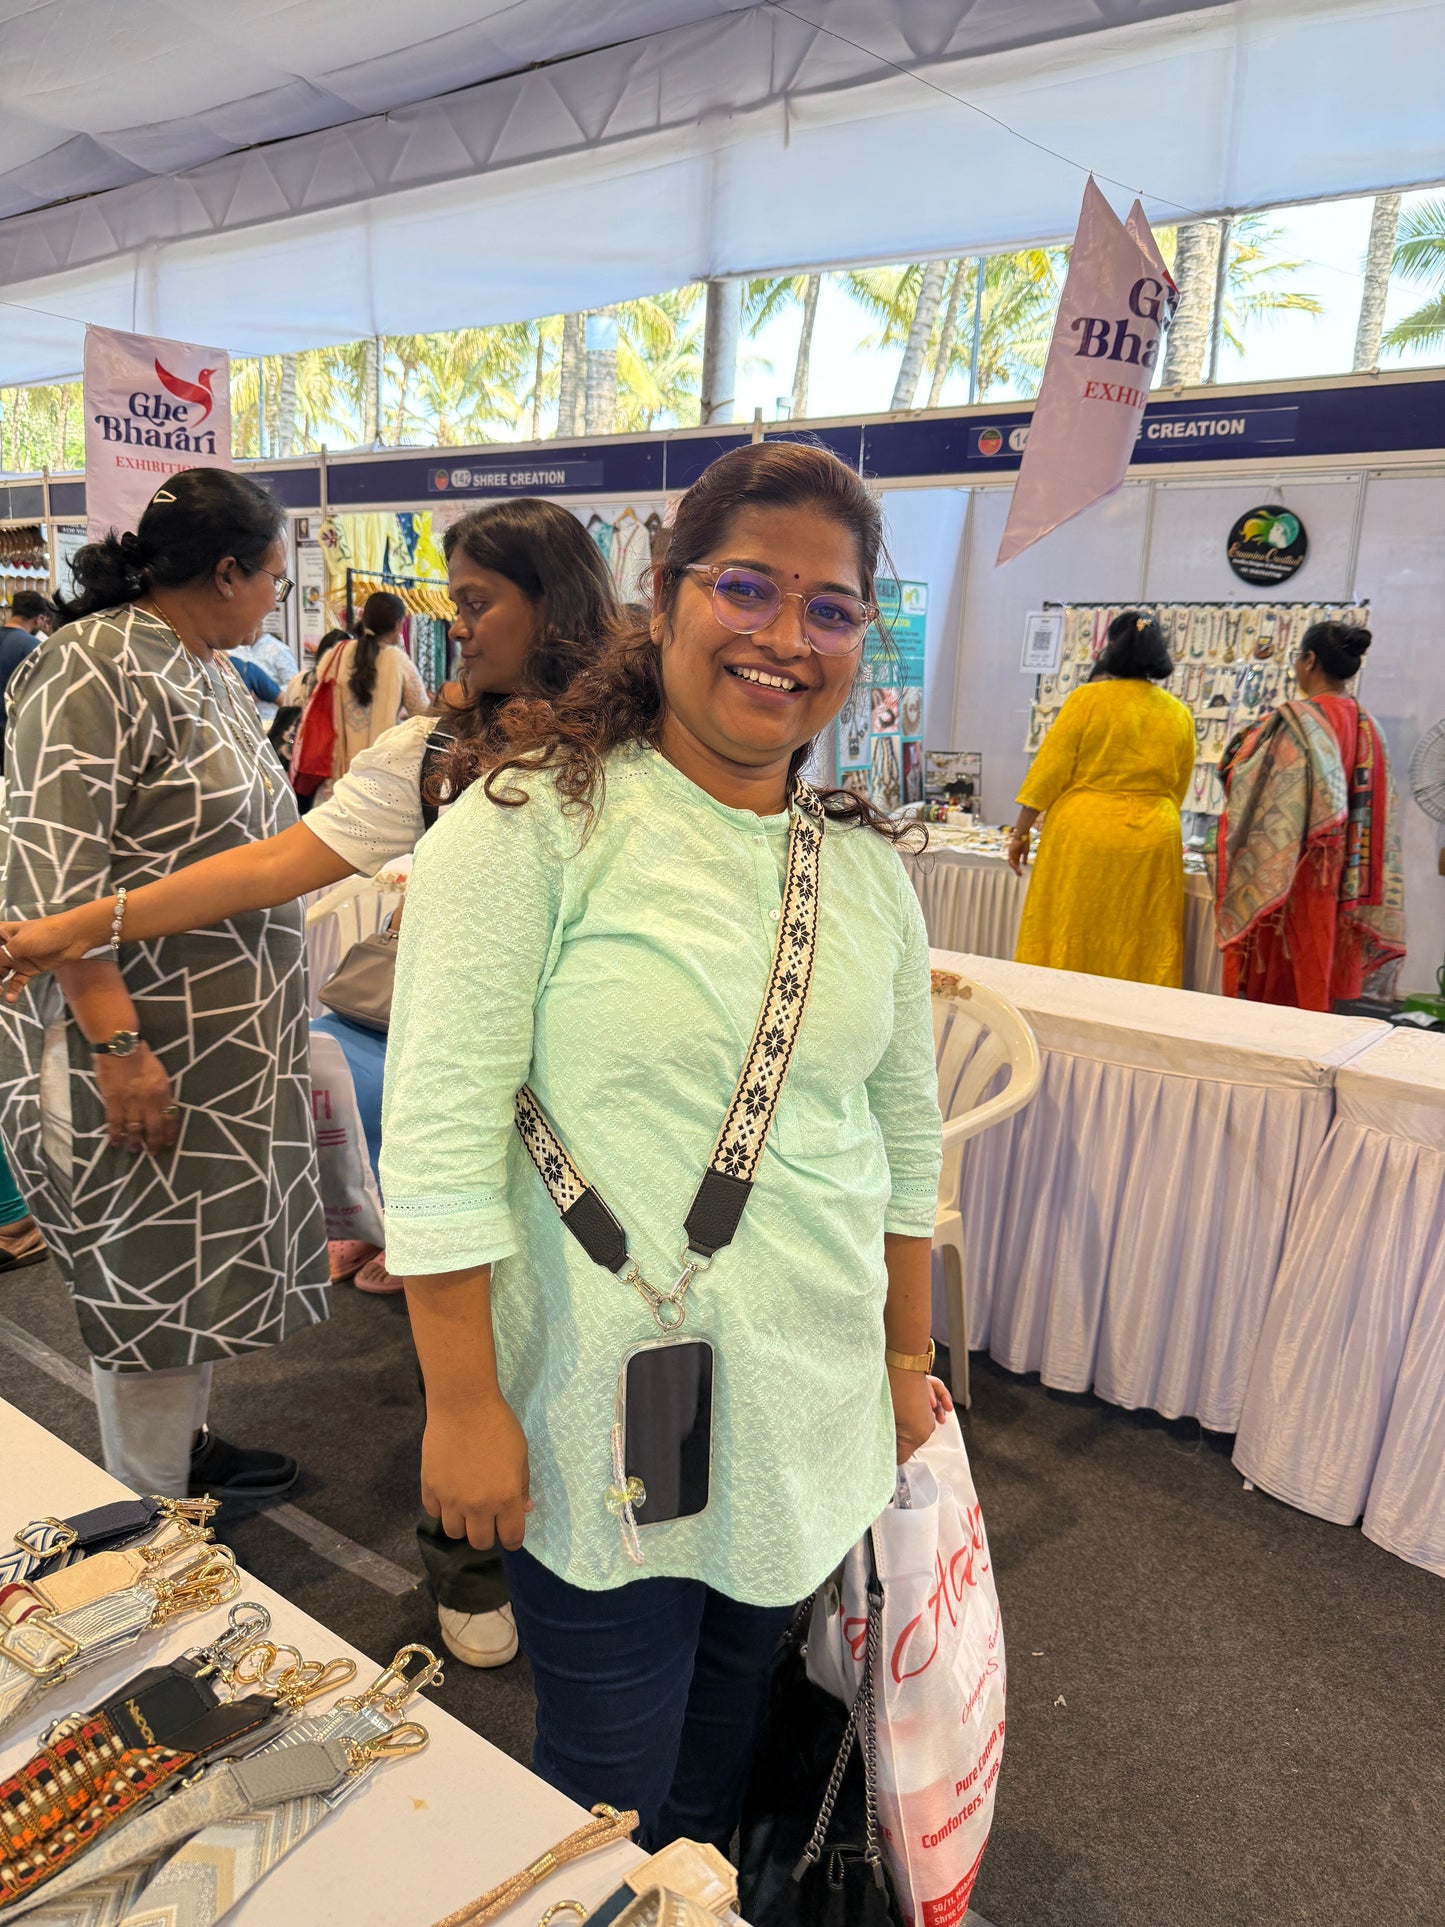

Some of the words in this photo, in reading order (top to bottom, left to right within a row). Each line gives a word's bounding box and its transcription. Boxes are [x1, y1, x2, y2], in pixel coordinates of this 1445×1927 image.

[128, 392, 188, 427] Ghe
[1147, 418, 1245, 440] CREATION
[115, 456, 197, 474] EXHIBITI
[473, 474, 507, 486] SHREE
[509, 470, 565, 486] CREATION
[955, 1766, 978, 1797] Pure
[978, 1729, 997, 1773] Cotton
[921, 1793, 984, 1849] Comforters,
[934, 1908, 956, 1926] Shree
